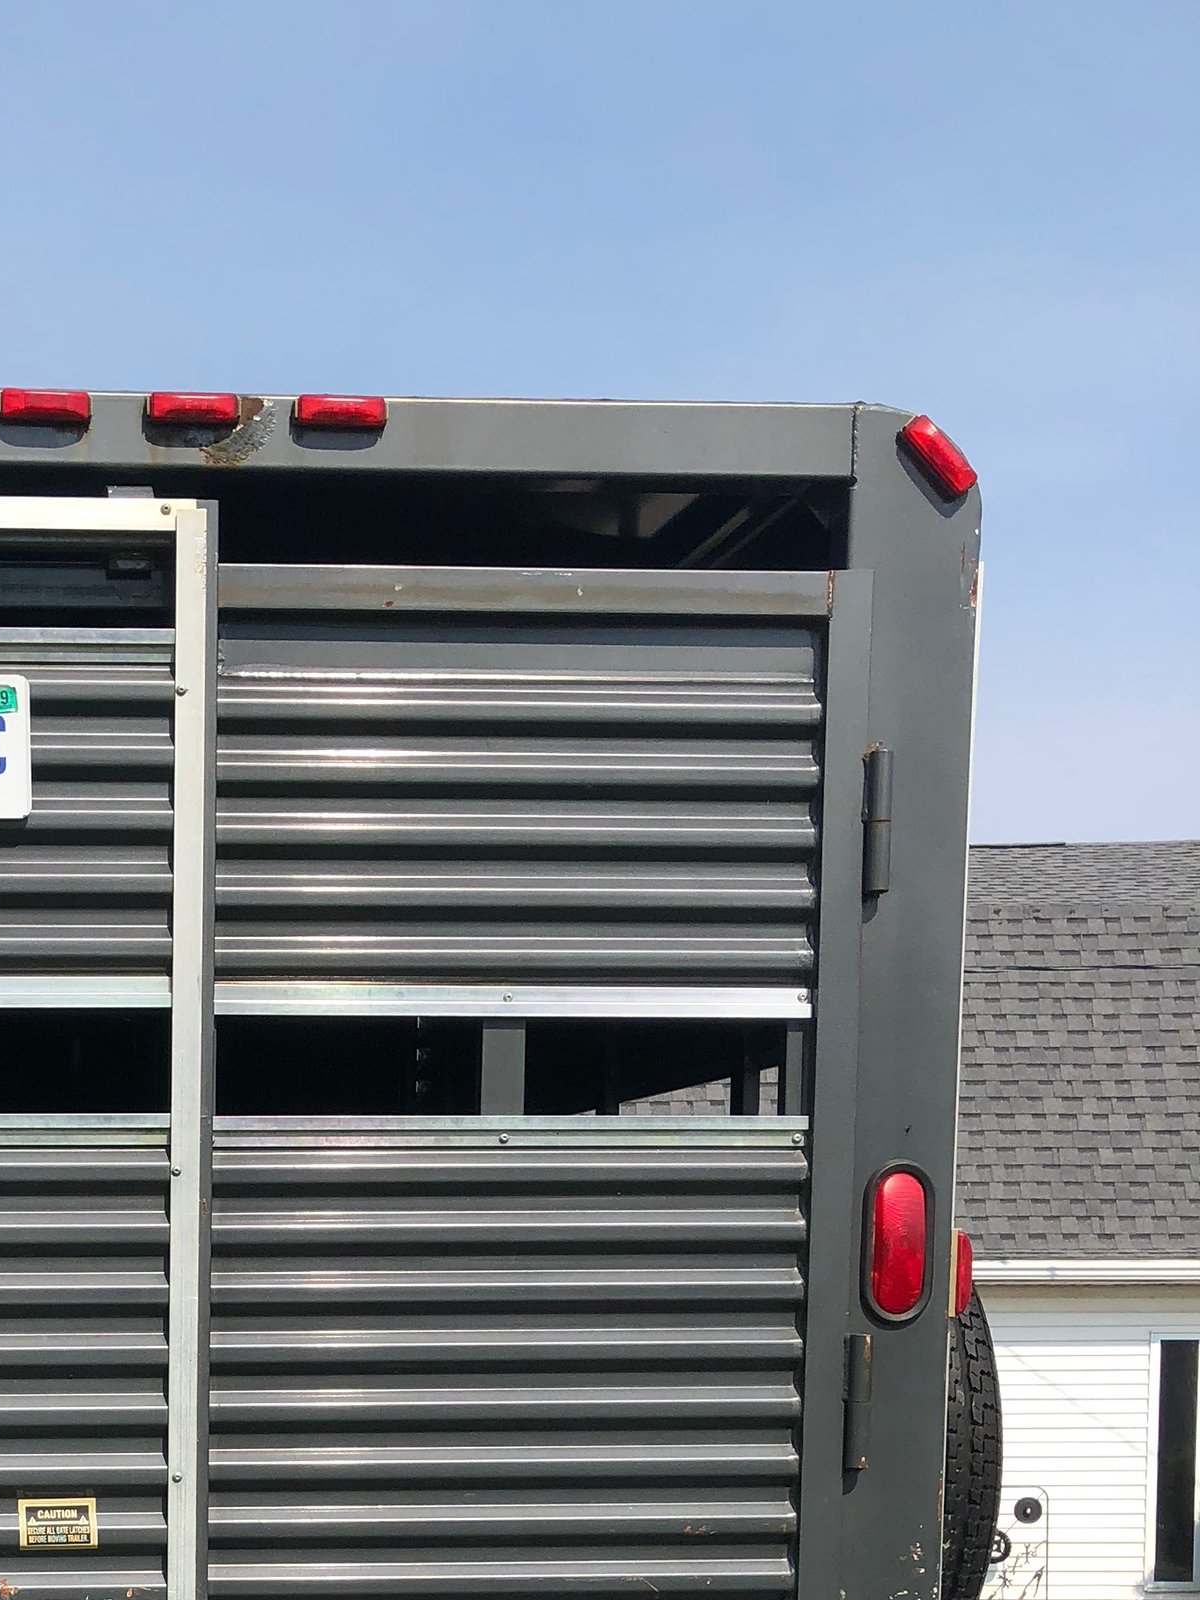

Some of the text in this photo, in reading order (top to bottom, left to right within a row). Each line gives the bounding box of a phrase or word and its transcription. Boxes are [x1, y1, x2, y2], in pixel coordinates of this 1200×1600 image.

[37, 1509, 78, 1519] CAUTION
[27, 1525, 90, 1535] SECURE ALL GATE LATCHES
[28, 1535, 47, 1543] BEFORE
[47, 1535, 67, 1543] MOVING
